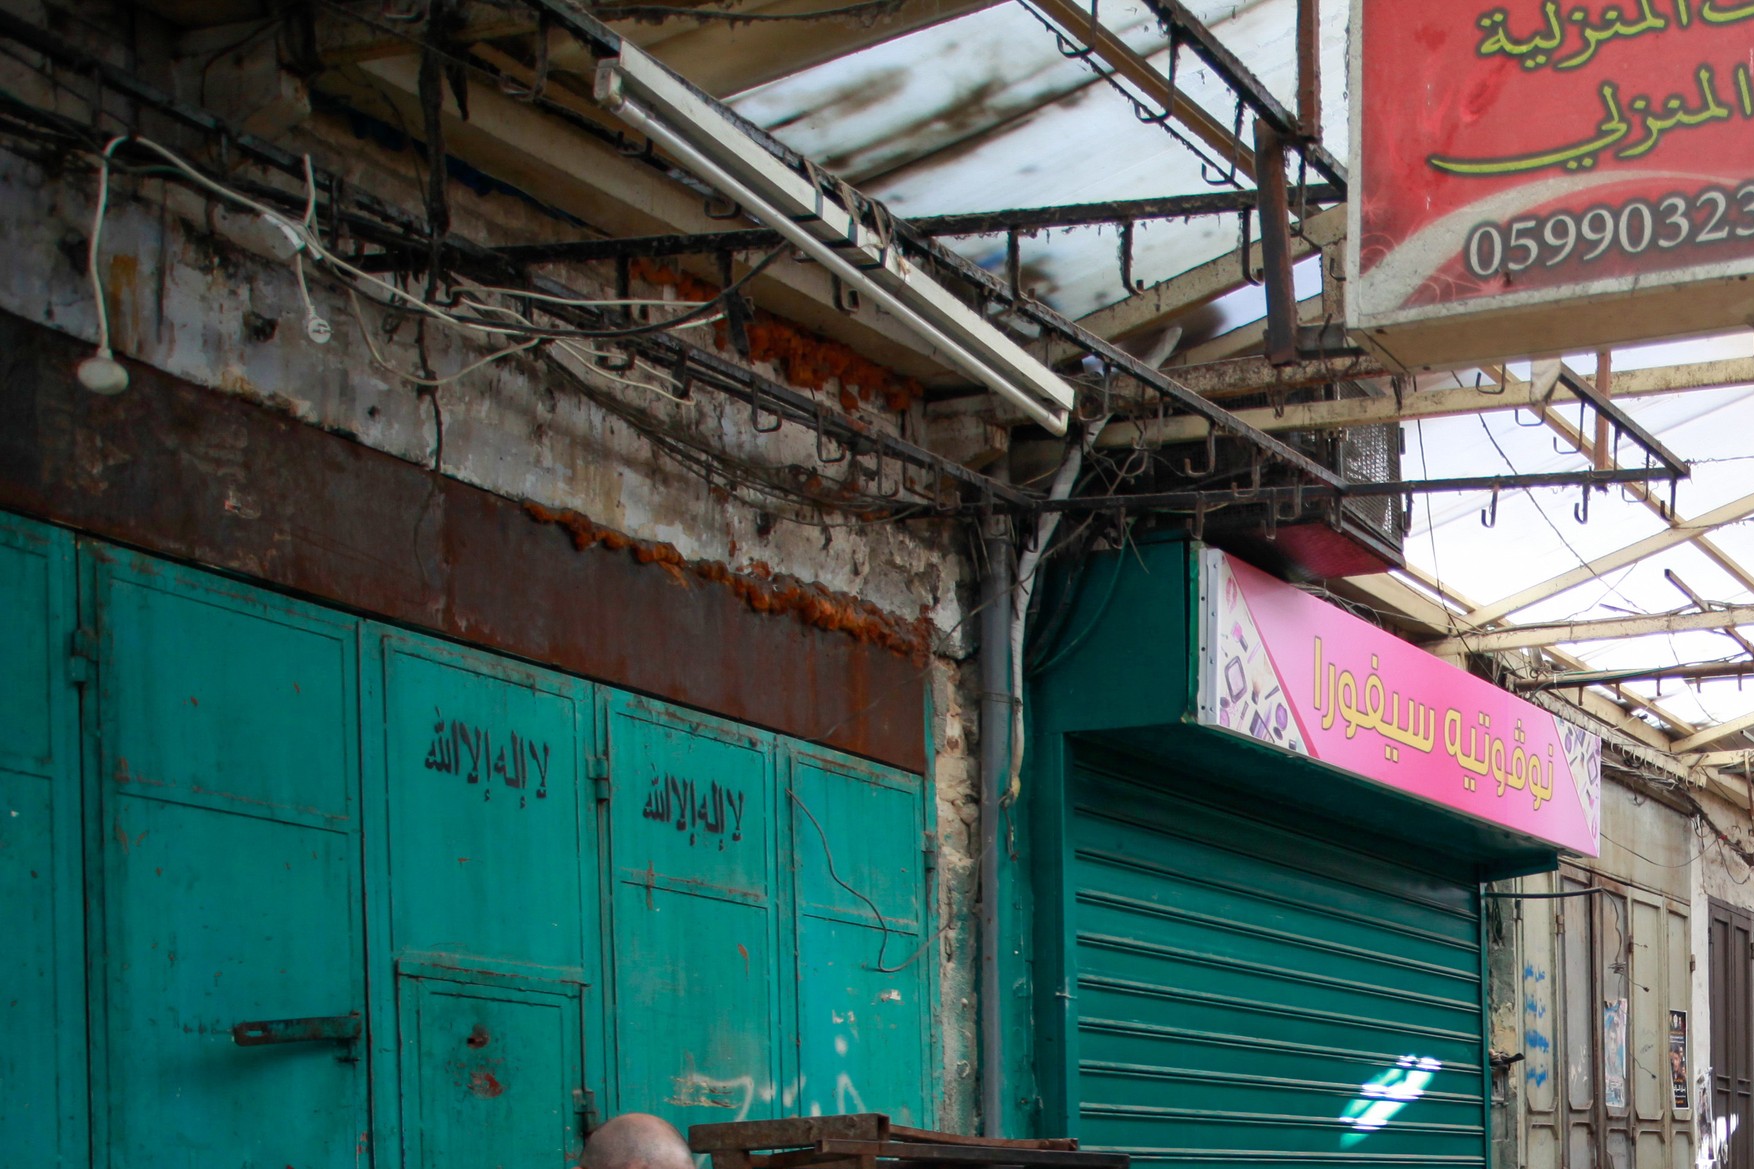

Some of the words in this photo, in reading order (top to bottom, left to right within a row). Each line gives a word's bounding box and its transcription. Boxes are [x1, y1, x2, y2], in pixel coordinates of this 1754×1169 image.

[1430, 67, 1753, 172] المنزلي
[425, 705, 460, 776] الله
[1314, 636, 1436, 763] سيفورا
[642, 762, 671, 823] الله
